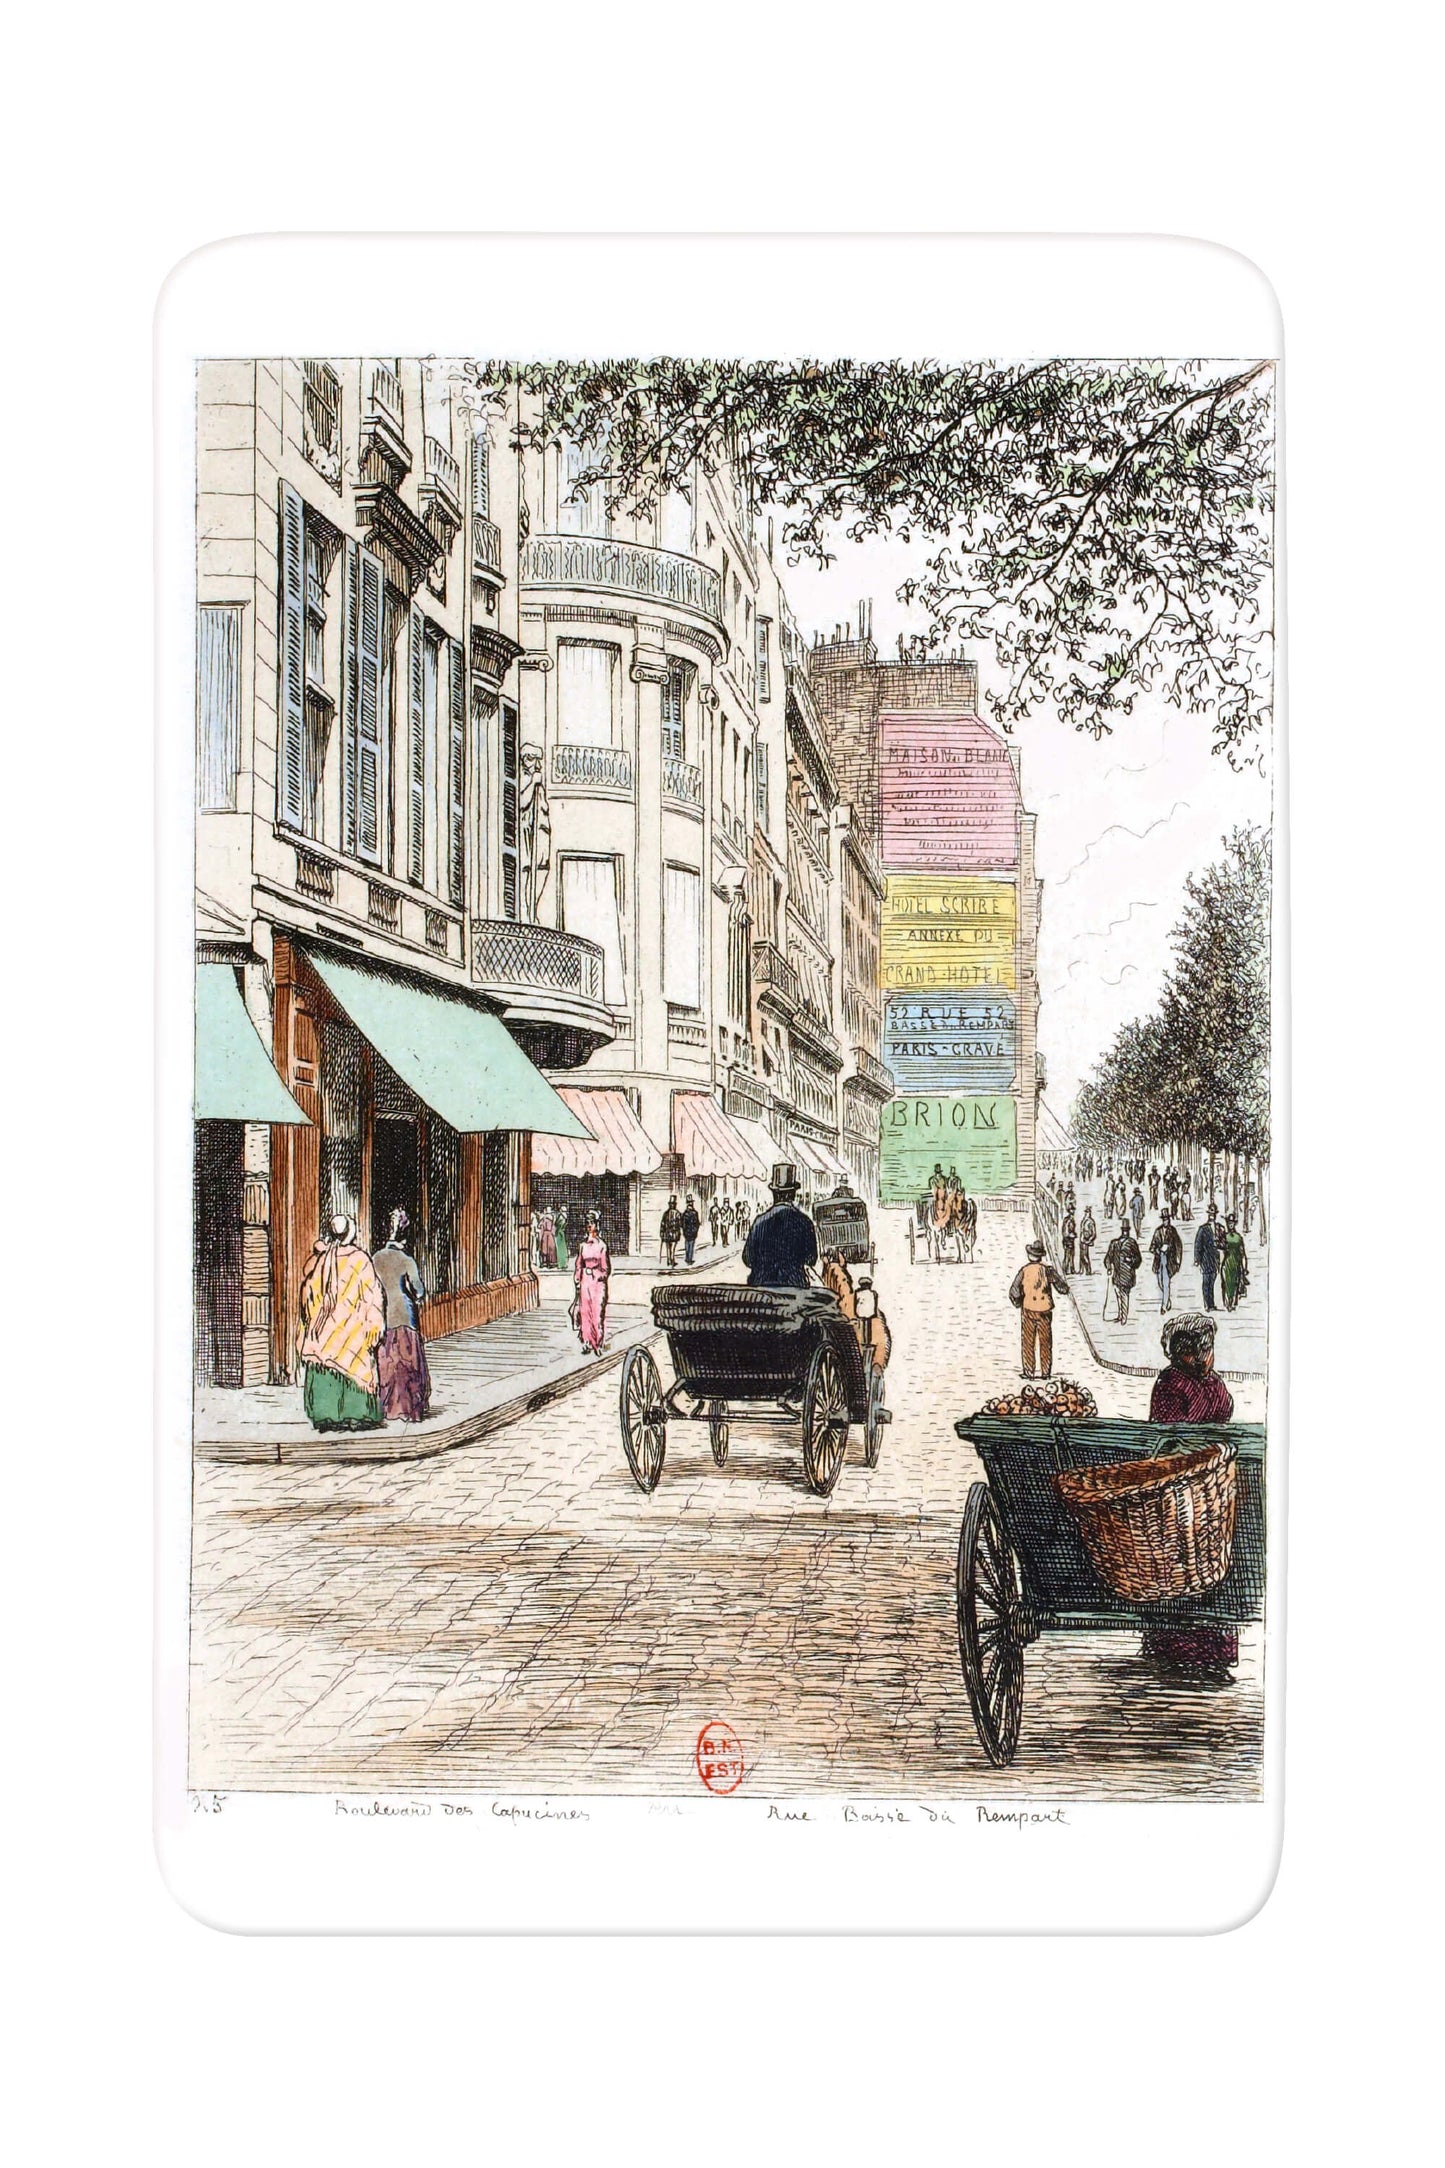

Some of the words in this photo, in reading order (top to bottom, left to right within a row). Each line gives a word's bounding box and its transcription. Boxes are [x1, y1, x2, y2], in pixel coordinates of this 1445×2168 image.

[940, 896, 1000, 914] SCRIBE
[908, 930, 963, 942] ANNEXE
[889, 1007, 908, 1019] 52
[921, 1007, 968, 1019] RUE
[984, 1006, 1005, 1019] 52
[892, 1043, 938, 1056] PARIS
[890, 1101, 998, 1127] BRION
[767, 1805, 815, 1822] Rue
[976, 1805, 1070, 1831] Rempart
